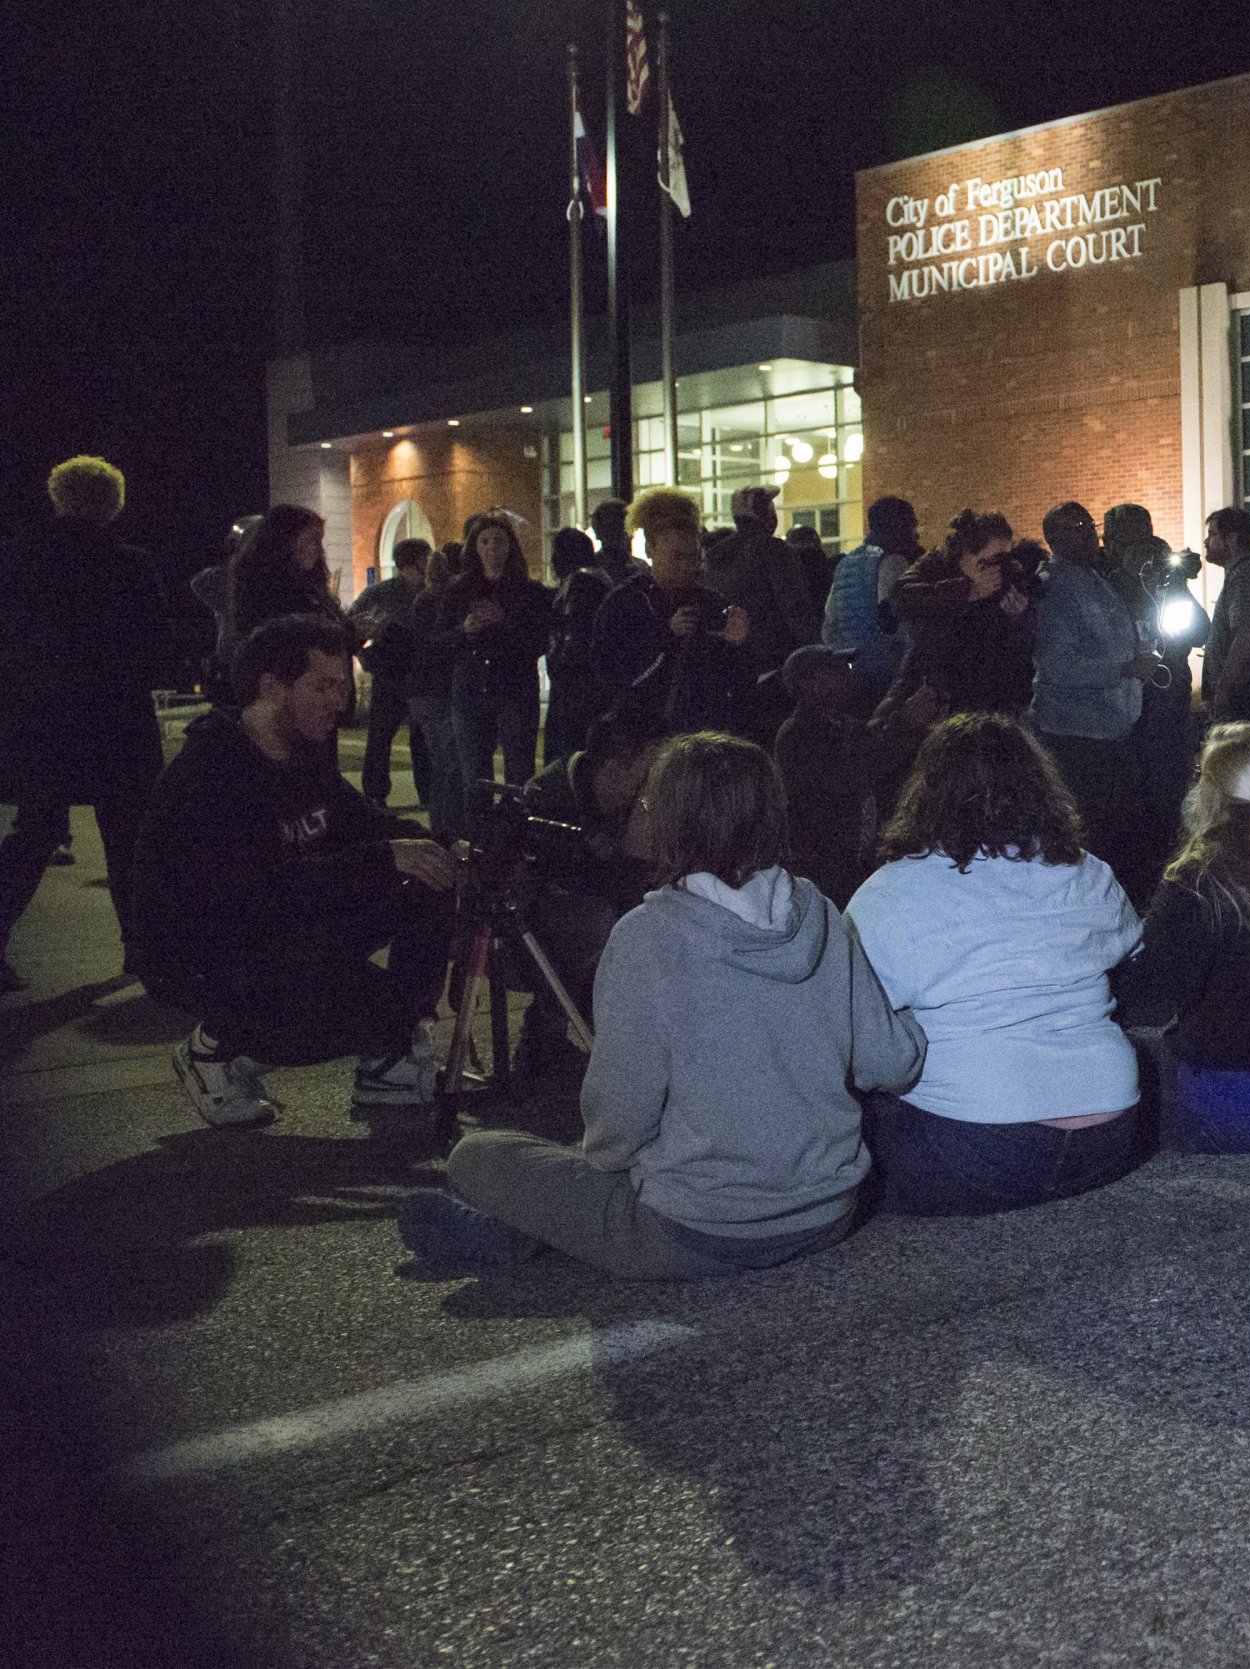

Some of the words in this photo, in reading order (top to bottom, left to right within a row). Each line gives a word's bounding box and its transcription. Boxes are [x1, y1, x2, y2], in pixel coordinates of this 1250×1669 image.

[886, 195, 929, 228] City
[935, 183, 960, 217] of
[966, 167, 1064, 208] Ferguson
[888, 219, 972, 265] POLICE
[978, 178, 1162, 247] DEPARTMENT
[888, 247, 1038, 302] MUNICIPAL
[1046, 223, 1146, 272] COURT
